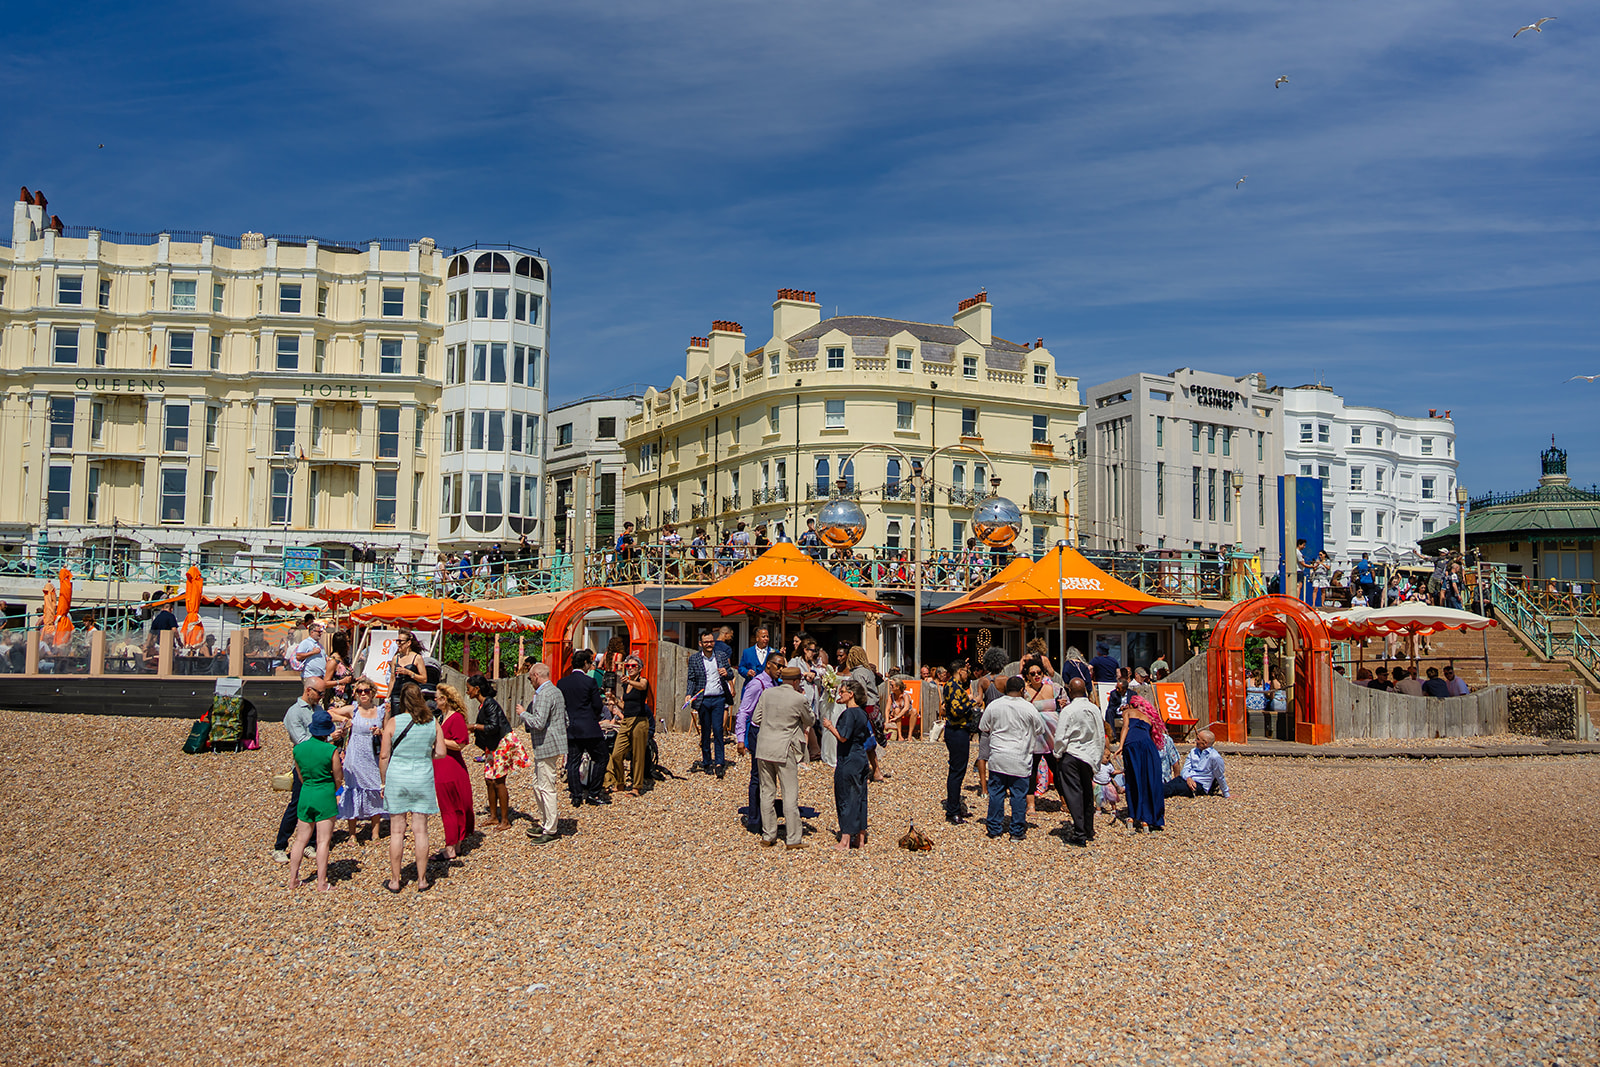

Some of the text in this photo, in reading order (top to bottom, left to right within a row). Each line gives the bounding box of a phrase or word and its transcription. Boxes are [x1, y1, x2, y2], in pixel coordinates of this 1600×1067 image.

[75, 377, 372, 398] QUEENS HOTEL
[1190, 384, 1240, 401] GROSVENOR
[1197, 395, 1233, 410] CASINOS
[753, 580, 798, 588] SOCIAL
[754, 574, 799, 583] OHSO
[1057, 577, 1101, 587] OHSO
